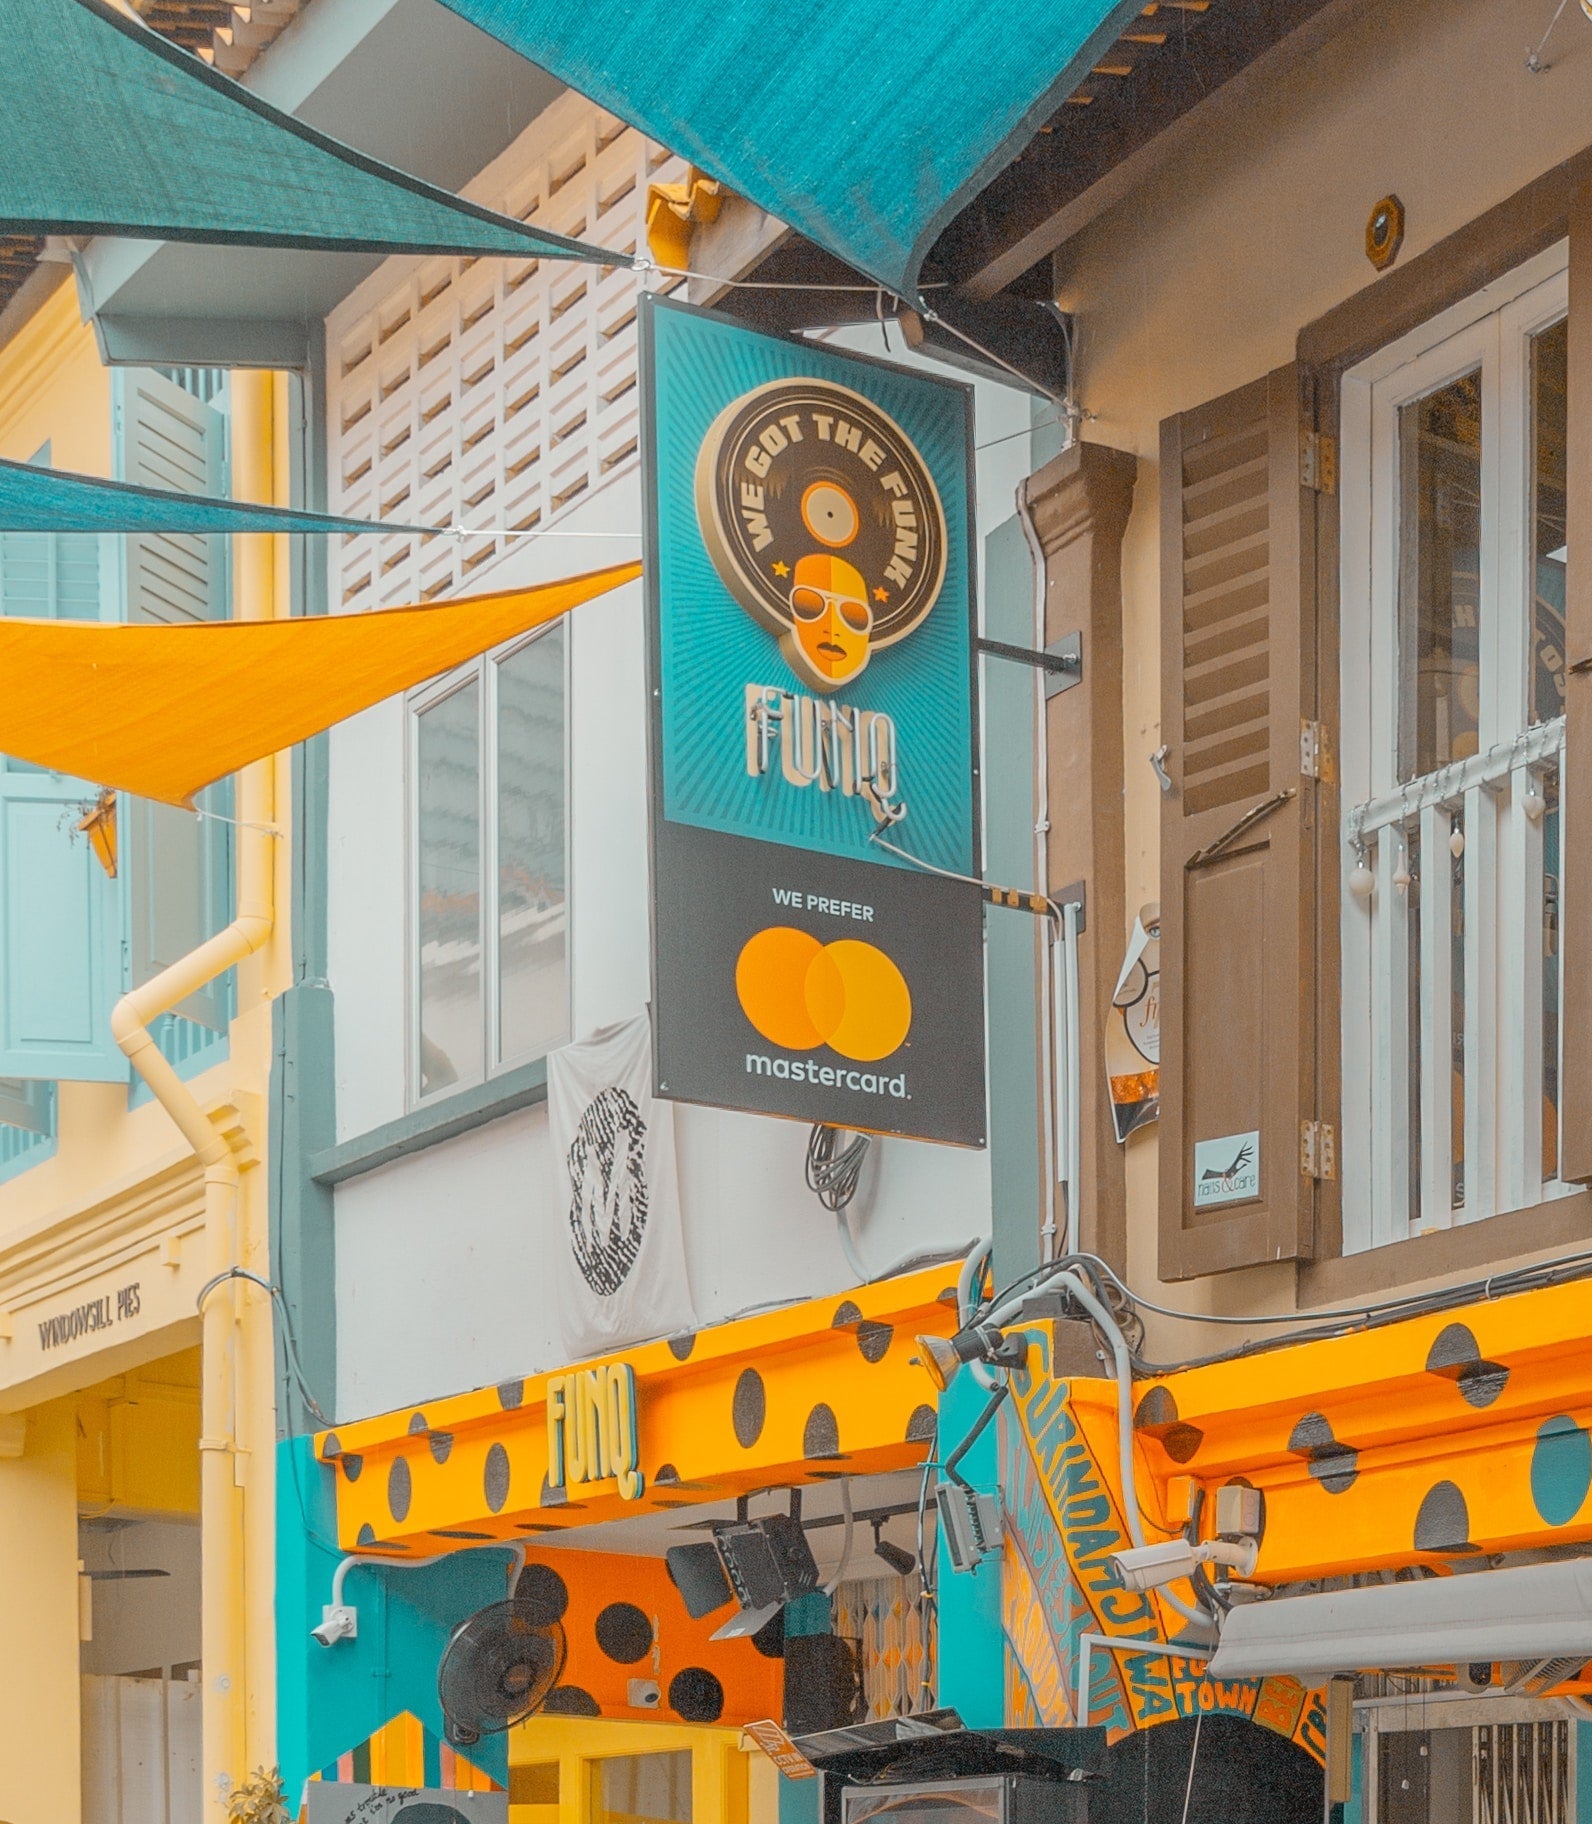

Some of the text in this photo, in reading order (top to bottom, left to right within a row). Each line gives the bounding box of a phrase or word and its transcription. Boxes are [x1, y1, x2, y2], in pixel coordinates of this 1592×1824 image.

[741, 413, 918, 591] WE GOT THE FUNK
[744, 683, 906, 824] FUNQ
[772, 888, 875, 924] WE PREFER
[117, 1282, 141, 1321] PIES
[547, 1361, 644, 1501] FUNQ
